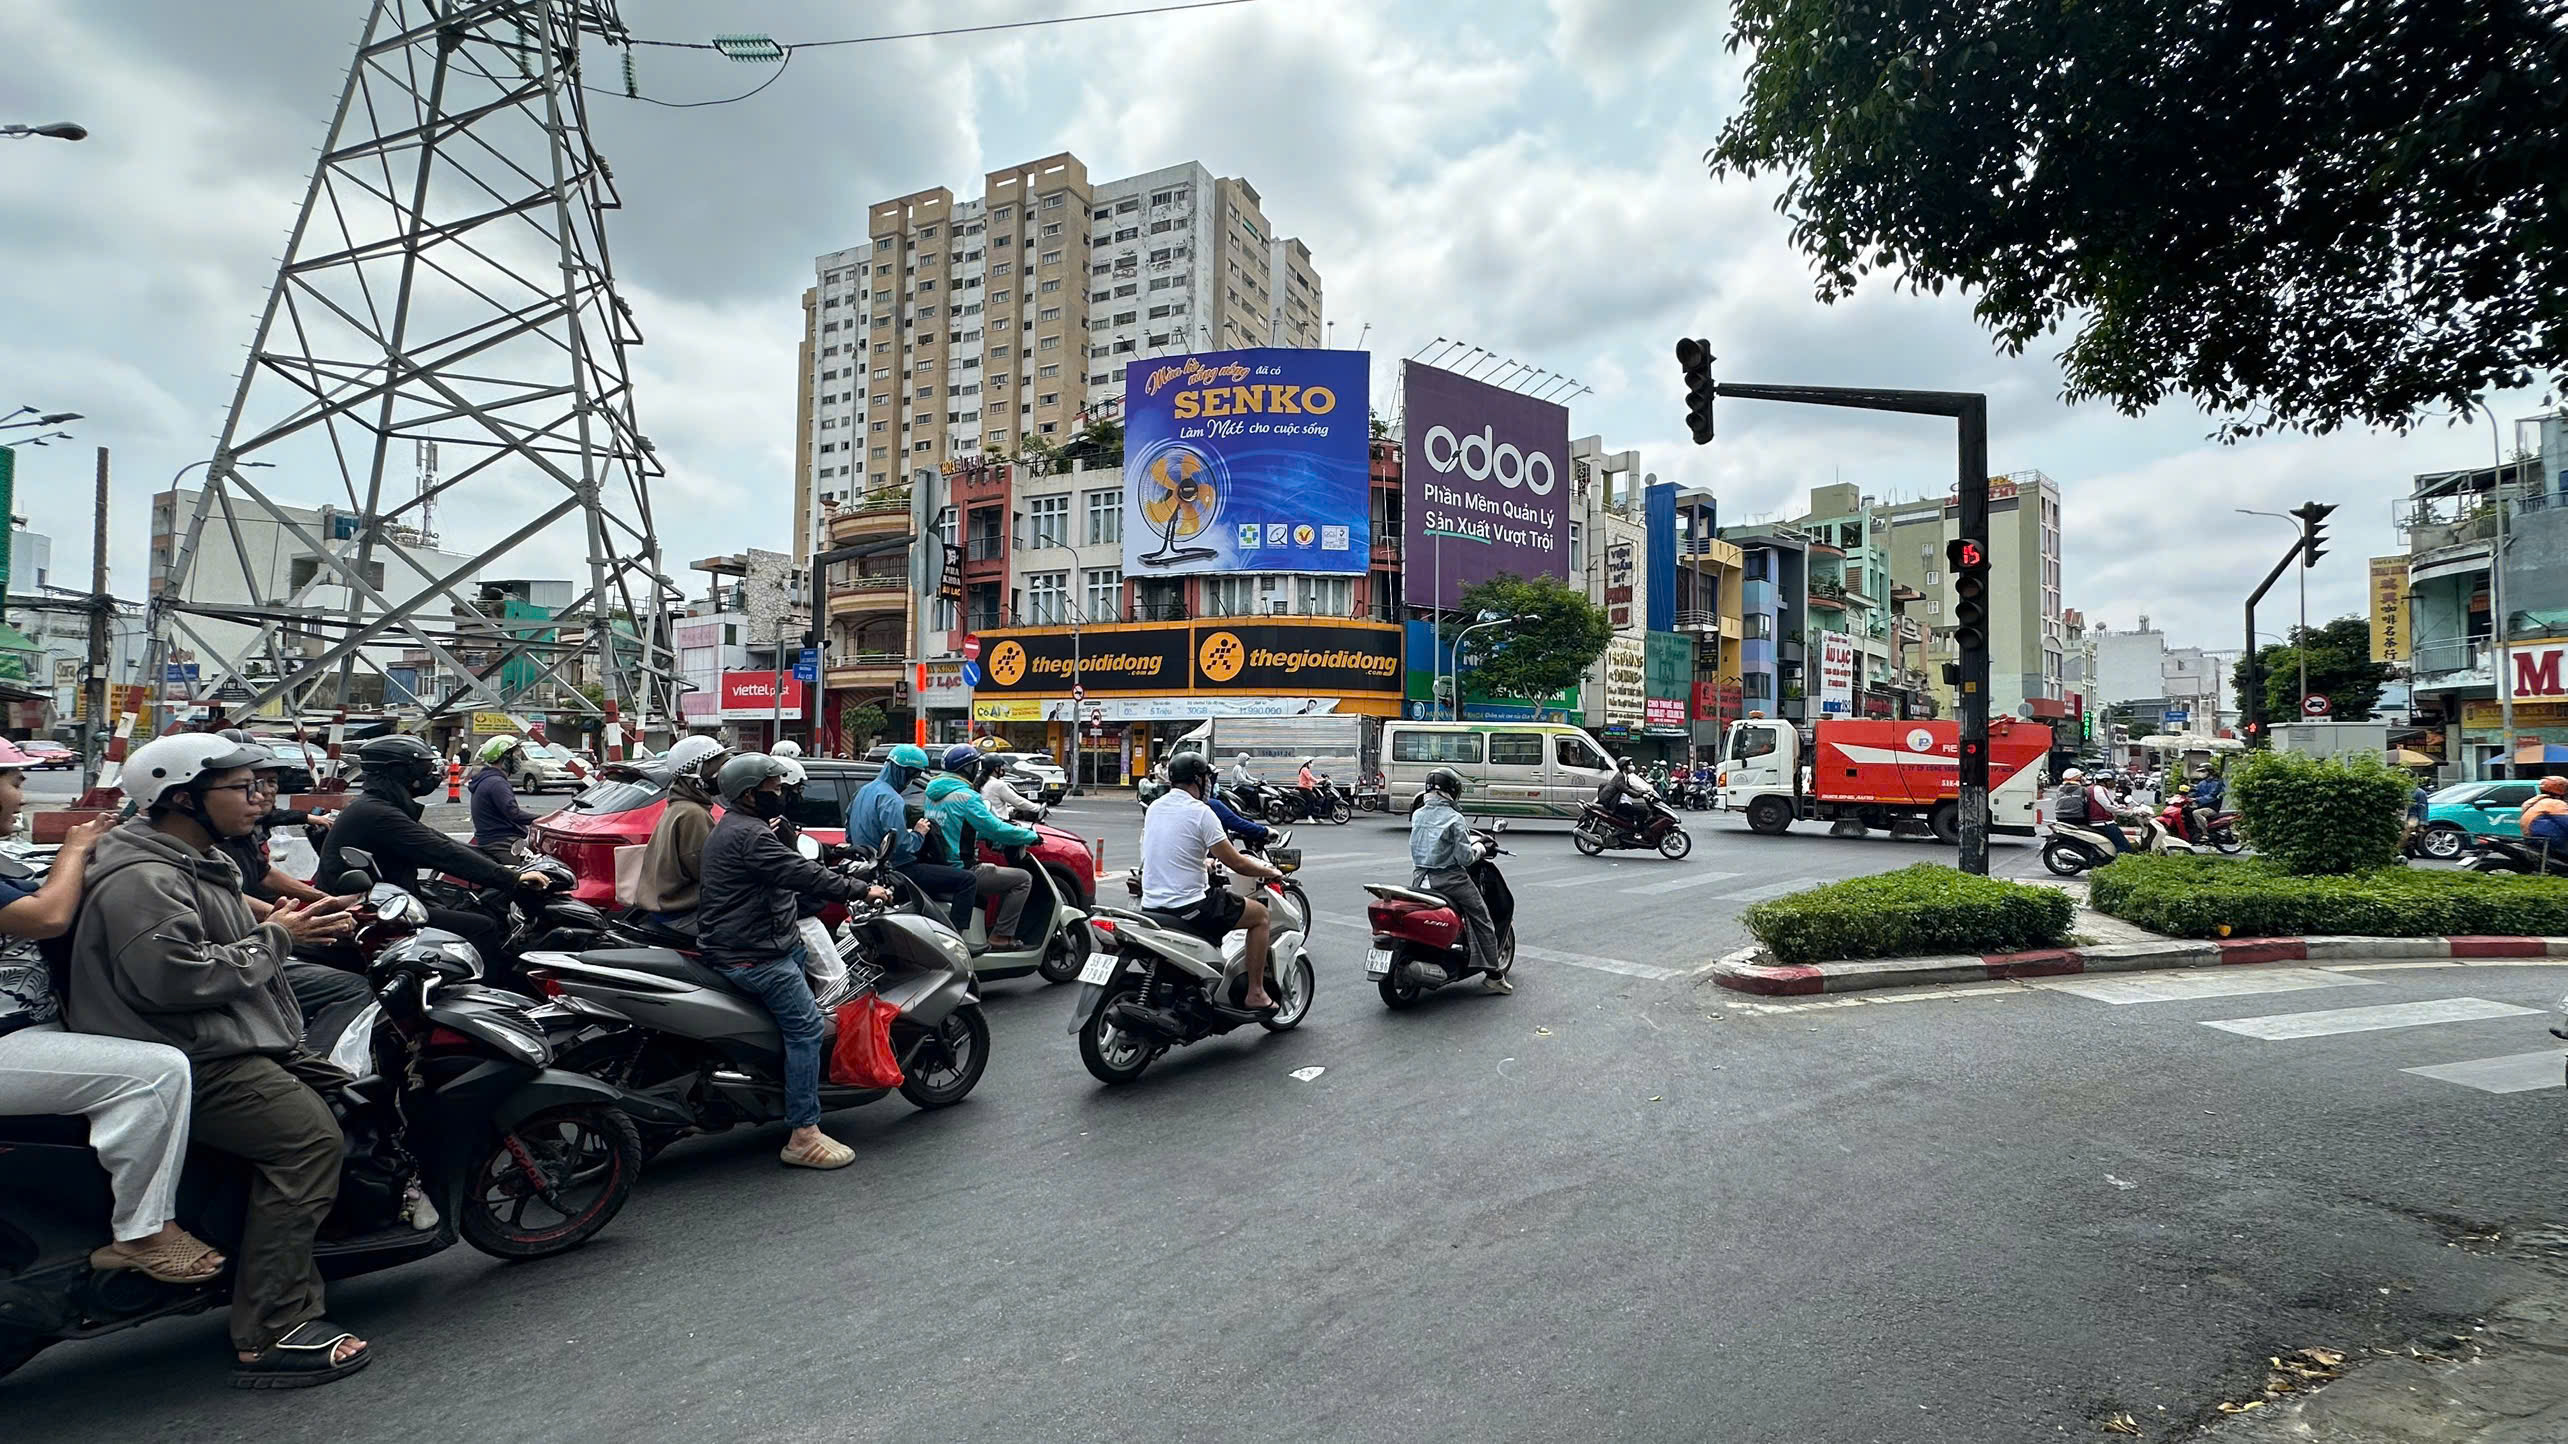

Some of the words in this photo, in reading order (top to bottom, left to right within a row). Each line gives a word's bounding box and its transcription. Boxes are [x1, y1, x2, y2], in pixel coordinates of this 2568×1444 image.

[1256, 365, 1269, 375] đã
[1271, 366, 1281, 376] có
[1174, 384, 1336, 419] SENKO
[1180, 426, 1204, 439] Làm
[1207, 419, 1244, 438] Mát
[1249, 422, 1270, 434] cho
[1274, 424, 1300, 437] cuộc
[1302, 421, 1329, 437] sống
[1424, 425, 1555, 496] odoo
[1425, 483, 1462, 507] Phần
[1465, 491, 1500, 515] Mềm
[1502, 501, 1538, 523] Quản
[1541, 508, 1554, 530] Lý
[1426, 511, 1454, 532] Sản
[1457, 516, 1491, 539] Xuất
[1494, 524, 1527, 548] Vượt
[1529, 531, 1554, 553] Trội
[1963, 544, 1980, 564] 15
[1250, 649, 1398, 676] thegioididong
[732, 684, 768, 696] viettel
